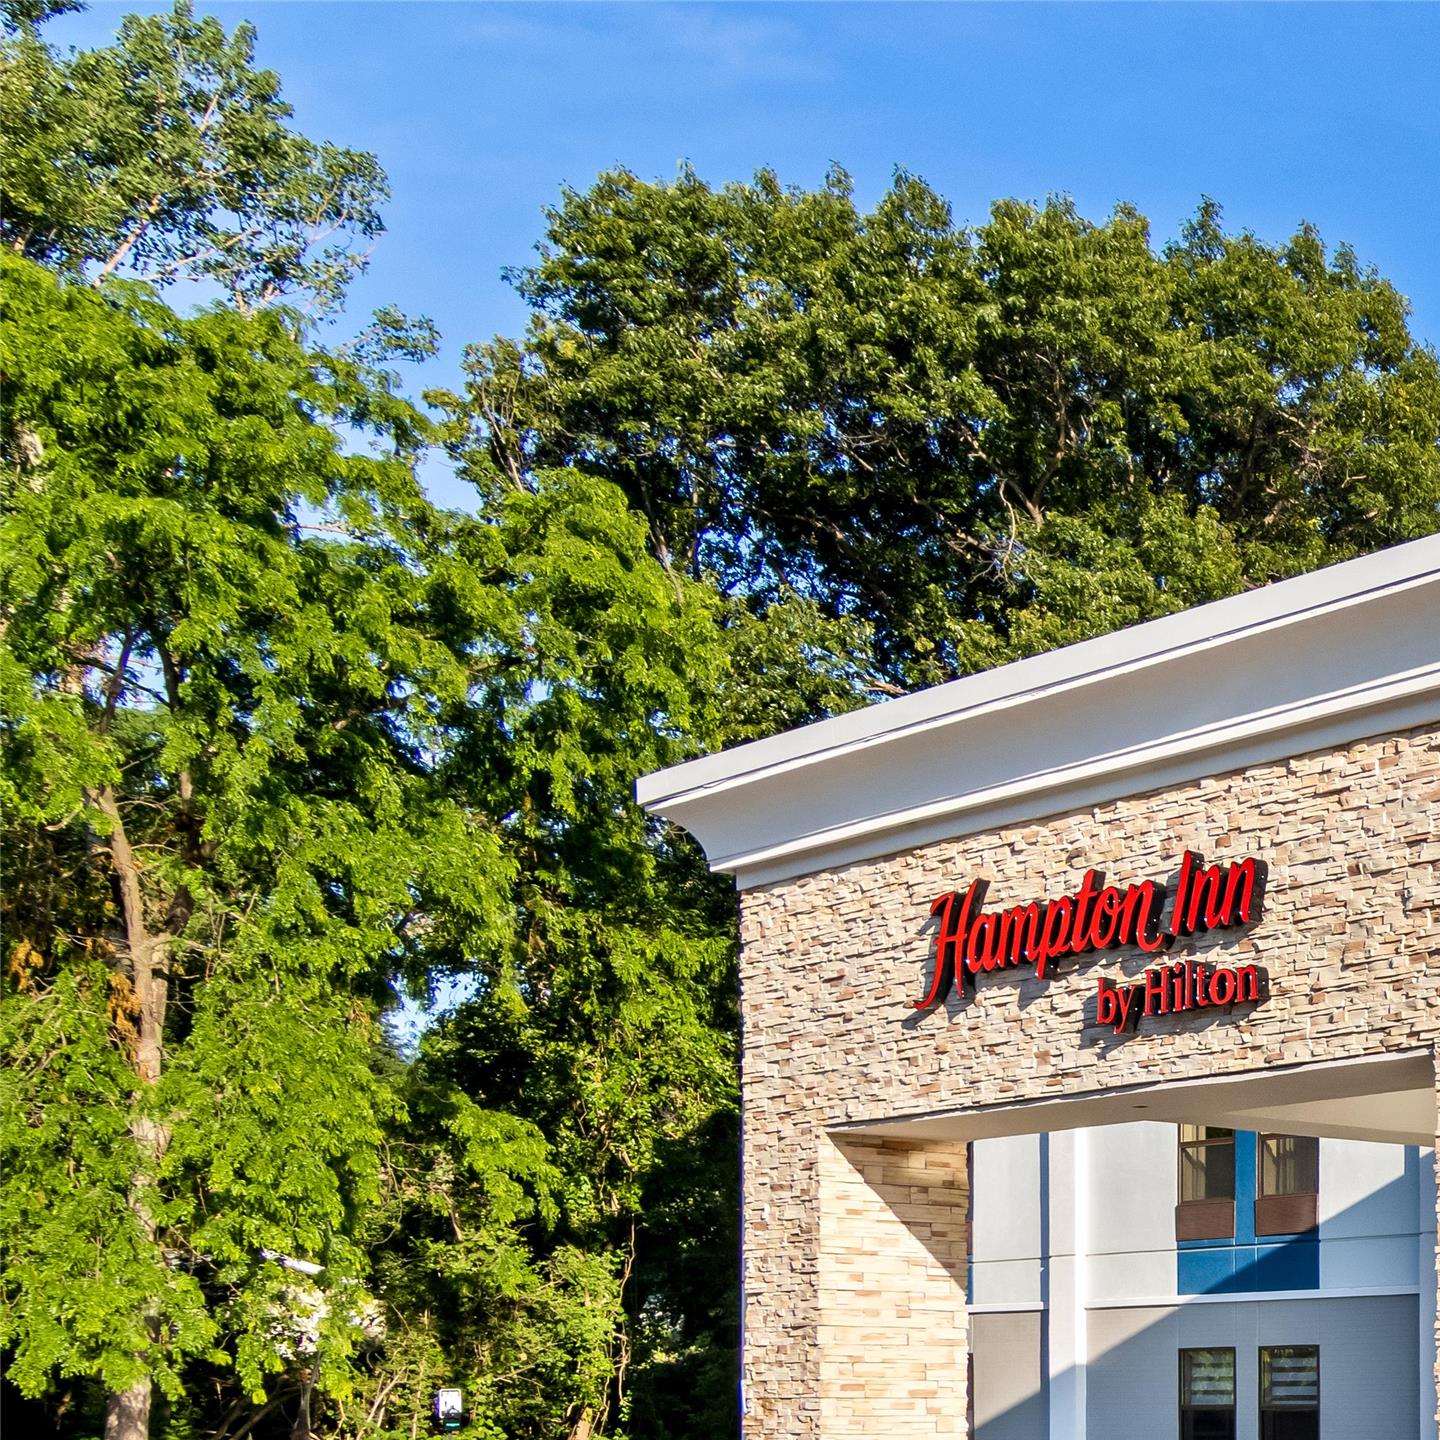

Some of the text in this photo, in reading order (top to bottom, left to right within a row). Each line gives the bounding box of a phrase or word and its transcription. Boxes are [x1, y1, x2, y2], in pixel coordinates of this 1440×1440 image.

[914, 850, 1257, 1010] Hampton Inn
[1097, 960, 1259, 1034] by Hilton
